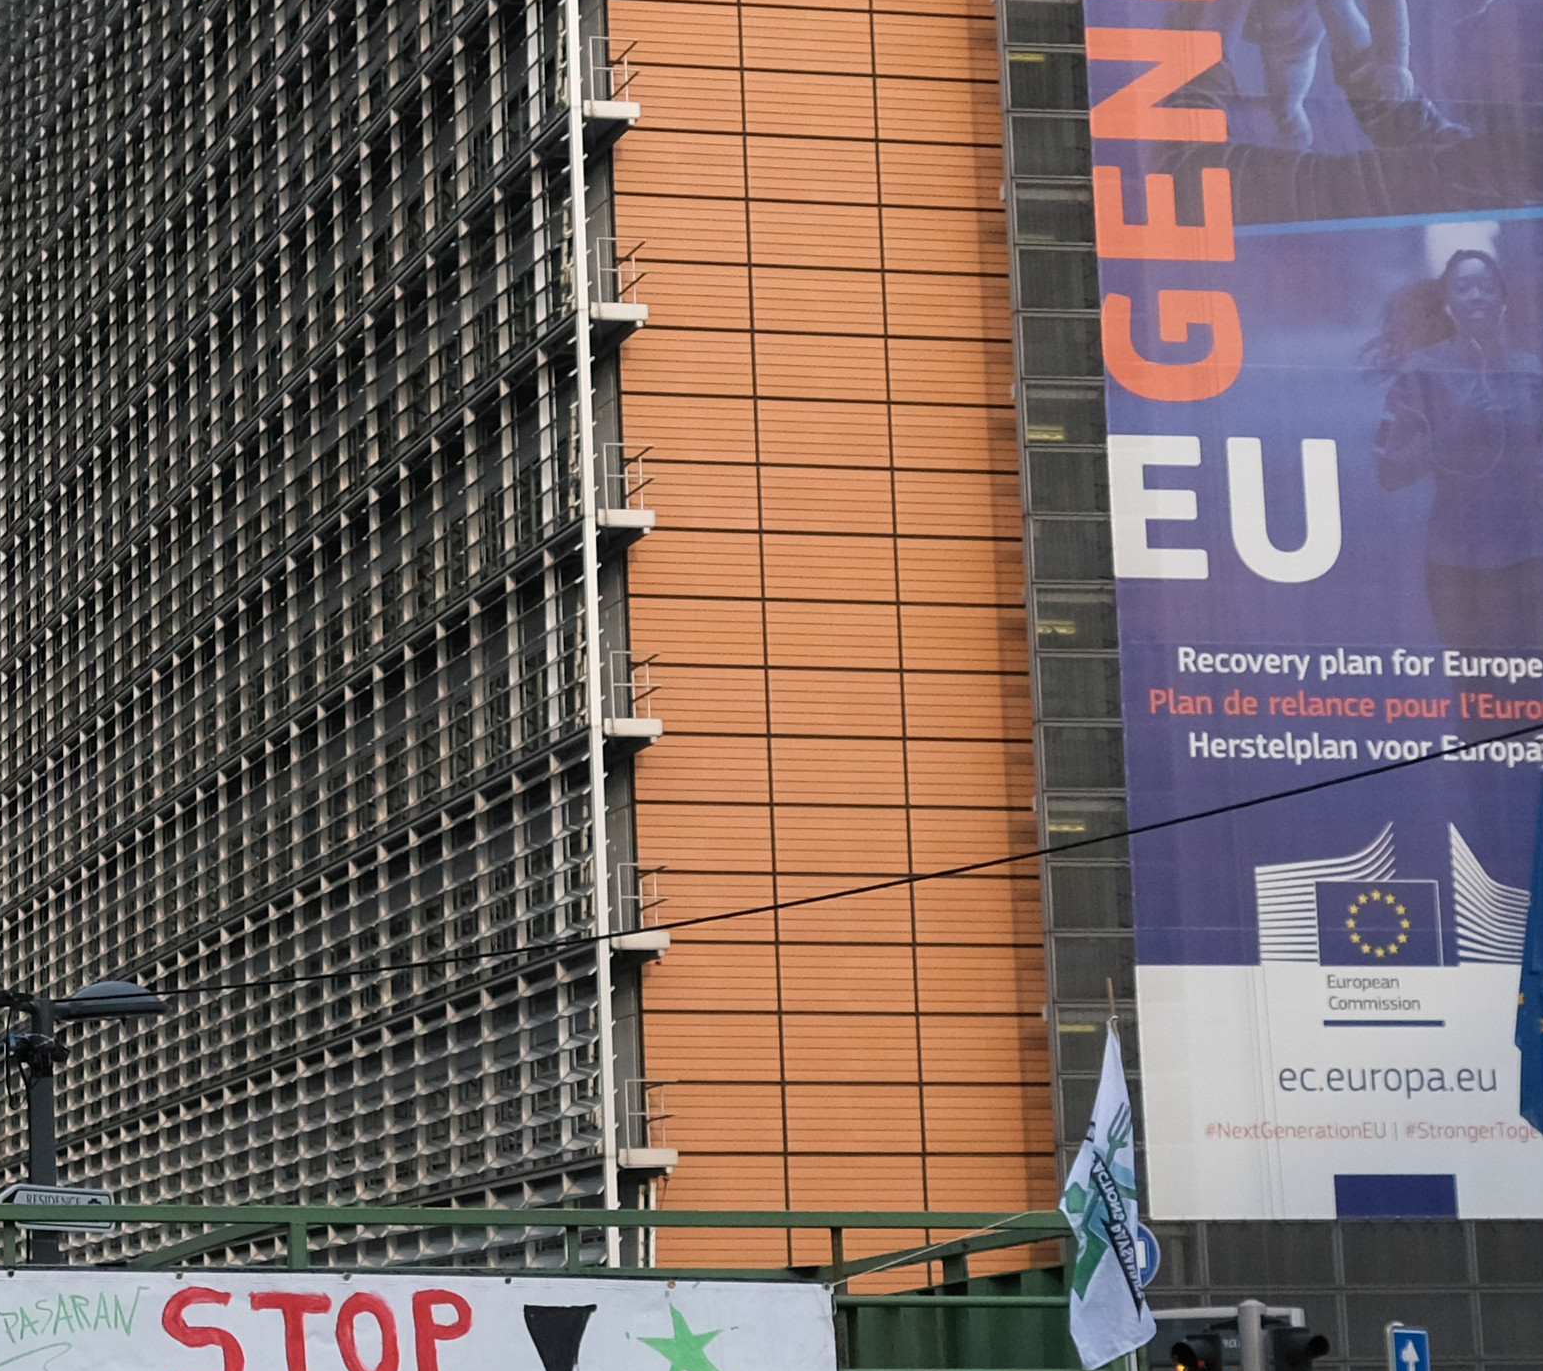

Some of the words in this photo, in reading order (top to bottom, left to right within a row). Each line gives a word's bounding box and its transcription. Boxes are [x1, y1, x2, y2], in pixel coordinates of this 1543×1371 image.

[1107, 432, 1344, 584] EU
[1178, 647, 1310, 679] Recovery
[1320, 649, 1382, 680] plan
[1393, 649, 1434, 676] for
[1444, 651, 1543, 683] Europe
[1149, 688, 1213, 715] Plan
[1224, 690, 1257, 716] de
[1269, 689, 1375, 717] relance
[1385, 696, 1450, 723] pour
[1189, 732, 1358, 765] Herstelplan
[1366, 738, 1433, 760] voor
[1441, 736, 1543, 767] Europa
[1327, 975, 1400, 991] European
[1329, 996, 1421, 1011] Commission
[1279, 1067, 1497, 1099] ec.europa.eu
[1205, 1122, 1386, 1141] #NextGenerationEU
